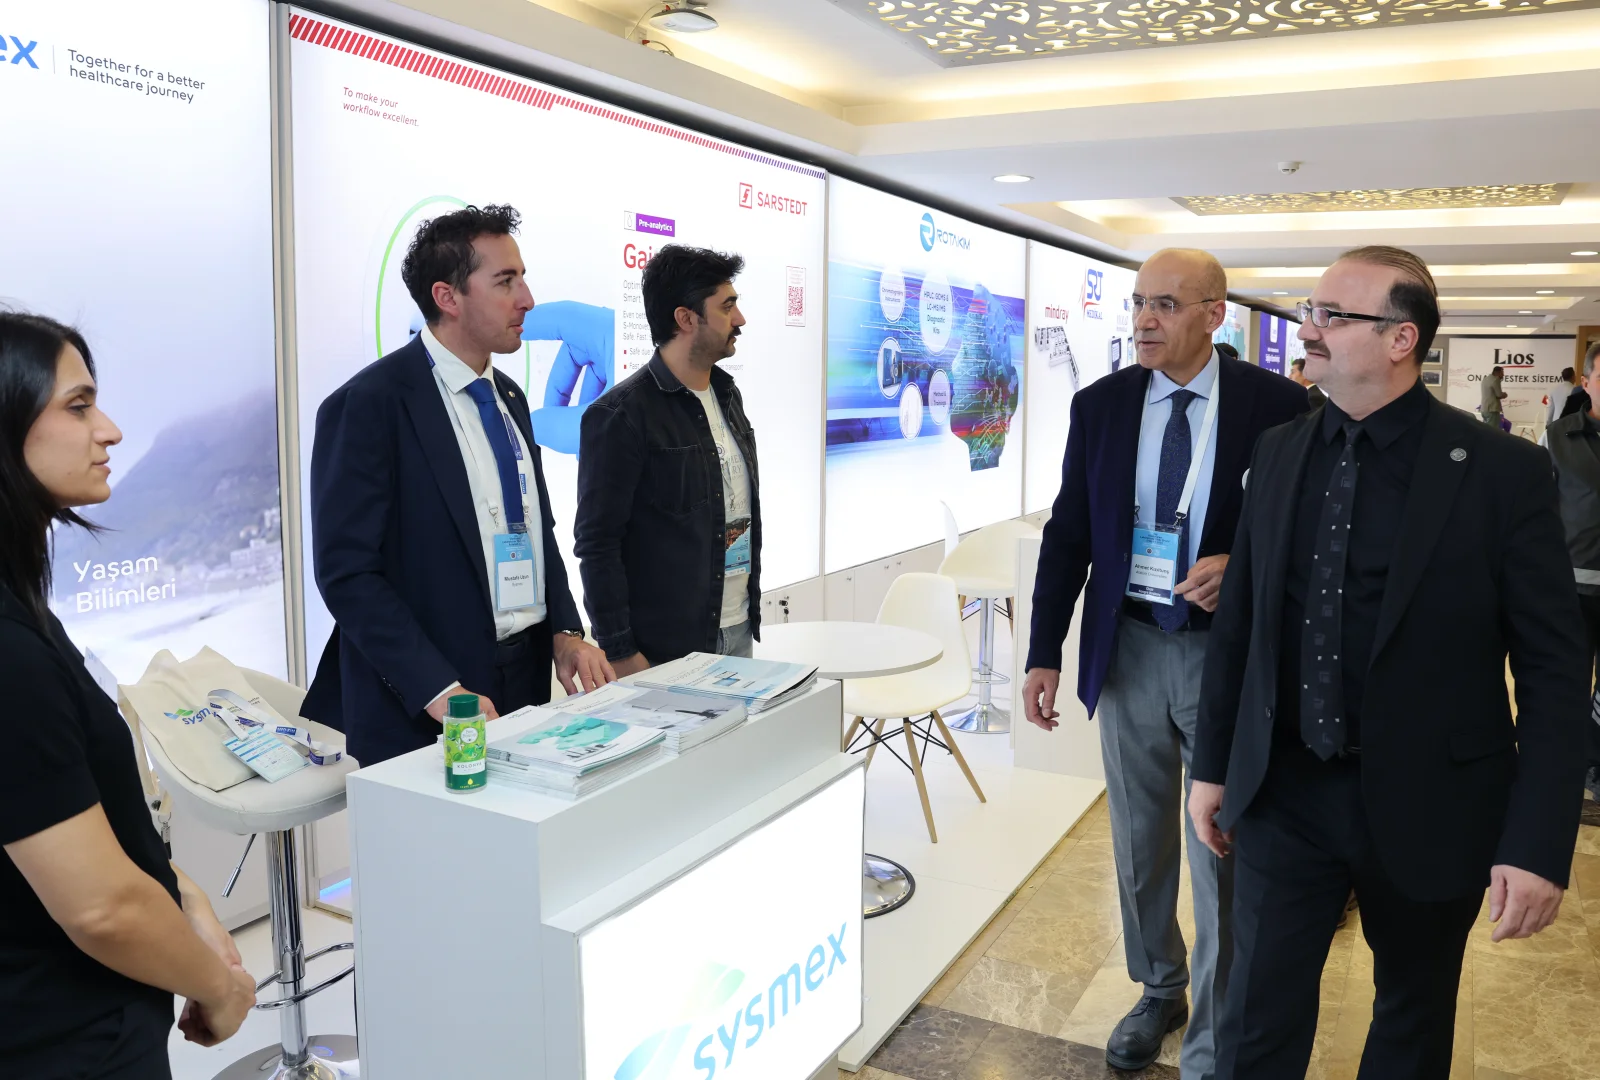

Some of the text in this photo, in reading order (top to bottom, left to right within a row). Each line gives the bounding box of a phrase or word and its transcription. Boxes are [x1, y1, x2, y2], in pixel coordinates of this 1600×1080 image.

[68, 48, 205, 90] Together for a better
[70, 65, 194, 104] healthcare journey
[343, 86, 399, 109] To make your
[343, 102, 419, 127] workflow excellent.
[757, 191, 808, 216] SARSTEDT
[638, 218, 673, 231] Pre-analytics
[936, 228, 971, 250] ROTAKIM
[624, 243, 659, 270] Gai
[1044, 304, 1069, 324] mindray
[1493, 348, 1535, 365] Lios
[1502, 374, 1529, 383] ESTEK
[1532, 373, 1564, 384] SİSTEM
[73, 556, 158, 582] Yaşam
[76, 578, 176, 613] Bilimleri
[693, 921, 848, 1080] sysmex
